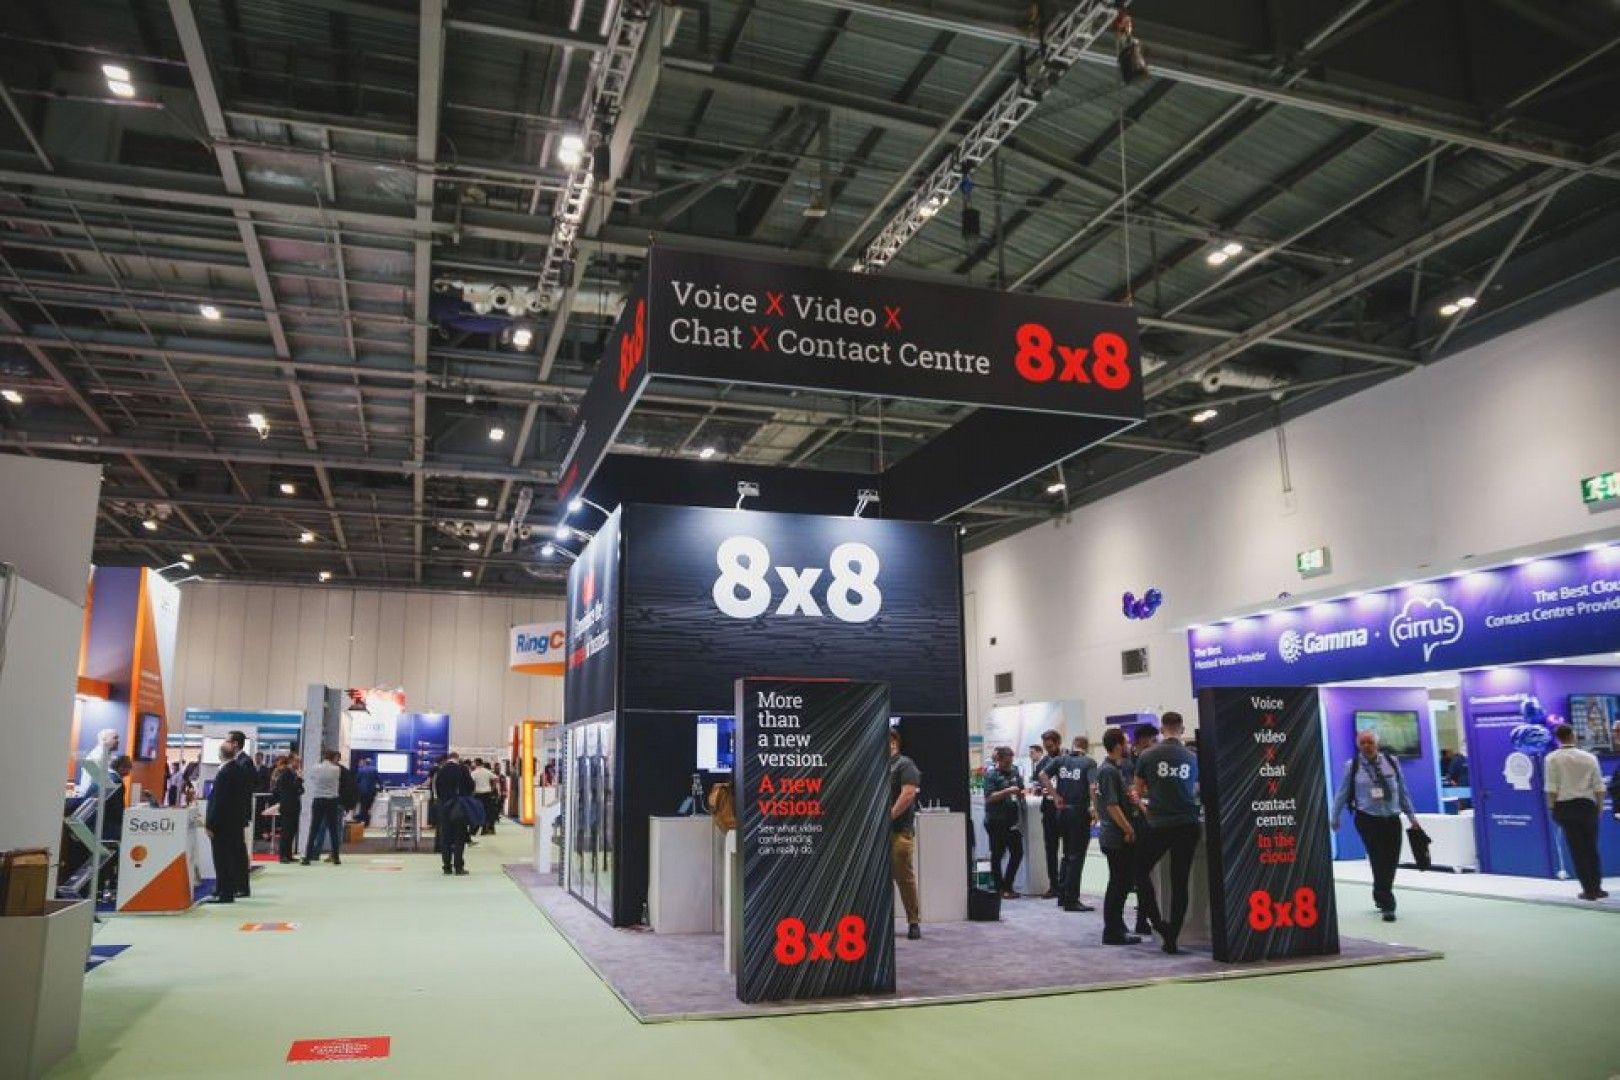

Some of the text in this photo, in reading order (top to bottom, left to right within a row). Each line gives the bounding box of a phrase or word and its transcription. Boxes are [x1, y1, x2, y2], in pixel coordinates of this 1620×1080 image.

[670, 280, 902, 330] Voice X Video X
[670, 318, 991, 376] Chat X Contact Centre
[1014, 322, 1131, 391] 8x8
[712, 535, 882, 622] 8x8
[1534, 590, 1559, 604] The
[1560, 585, 1589, 600] Best
[1485, 611, 1531, 628] Contact
[1532, 606, 1575, 622] Centre
[1396, 616, 1455, 640] cirrus
[1303, 628, 1368, 654] Gamma
[757, 691, 803, 709] More
[1251, 697, 1285, 710] Voice
[757, 711, 801, 728] than
[758, 732, 811, 747] a new
[1254, 729, 1287, 744] video
[757, 750, 828, 767] version.
[1059, 767, 1081, 781] 8x8
[1157, 761, 1190, 778] 8x8
[1259, 763, 1287, 777] chat
[758, 774, 823, 793] A new
[757, 797, 826, 817] vision.
[1251, 799, 1297, 812] contact
[1249, 887, 1318, 931] 8x8
[774, 915, 867, 965] 8x8
